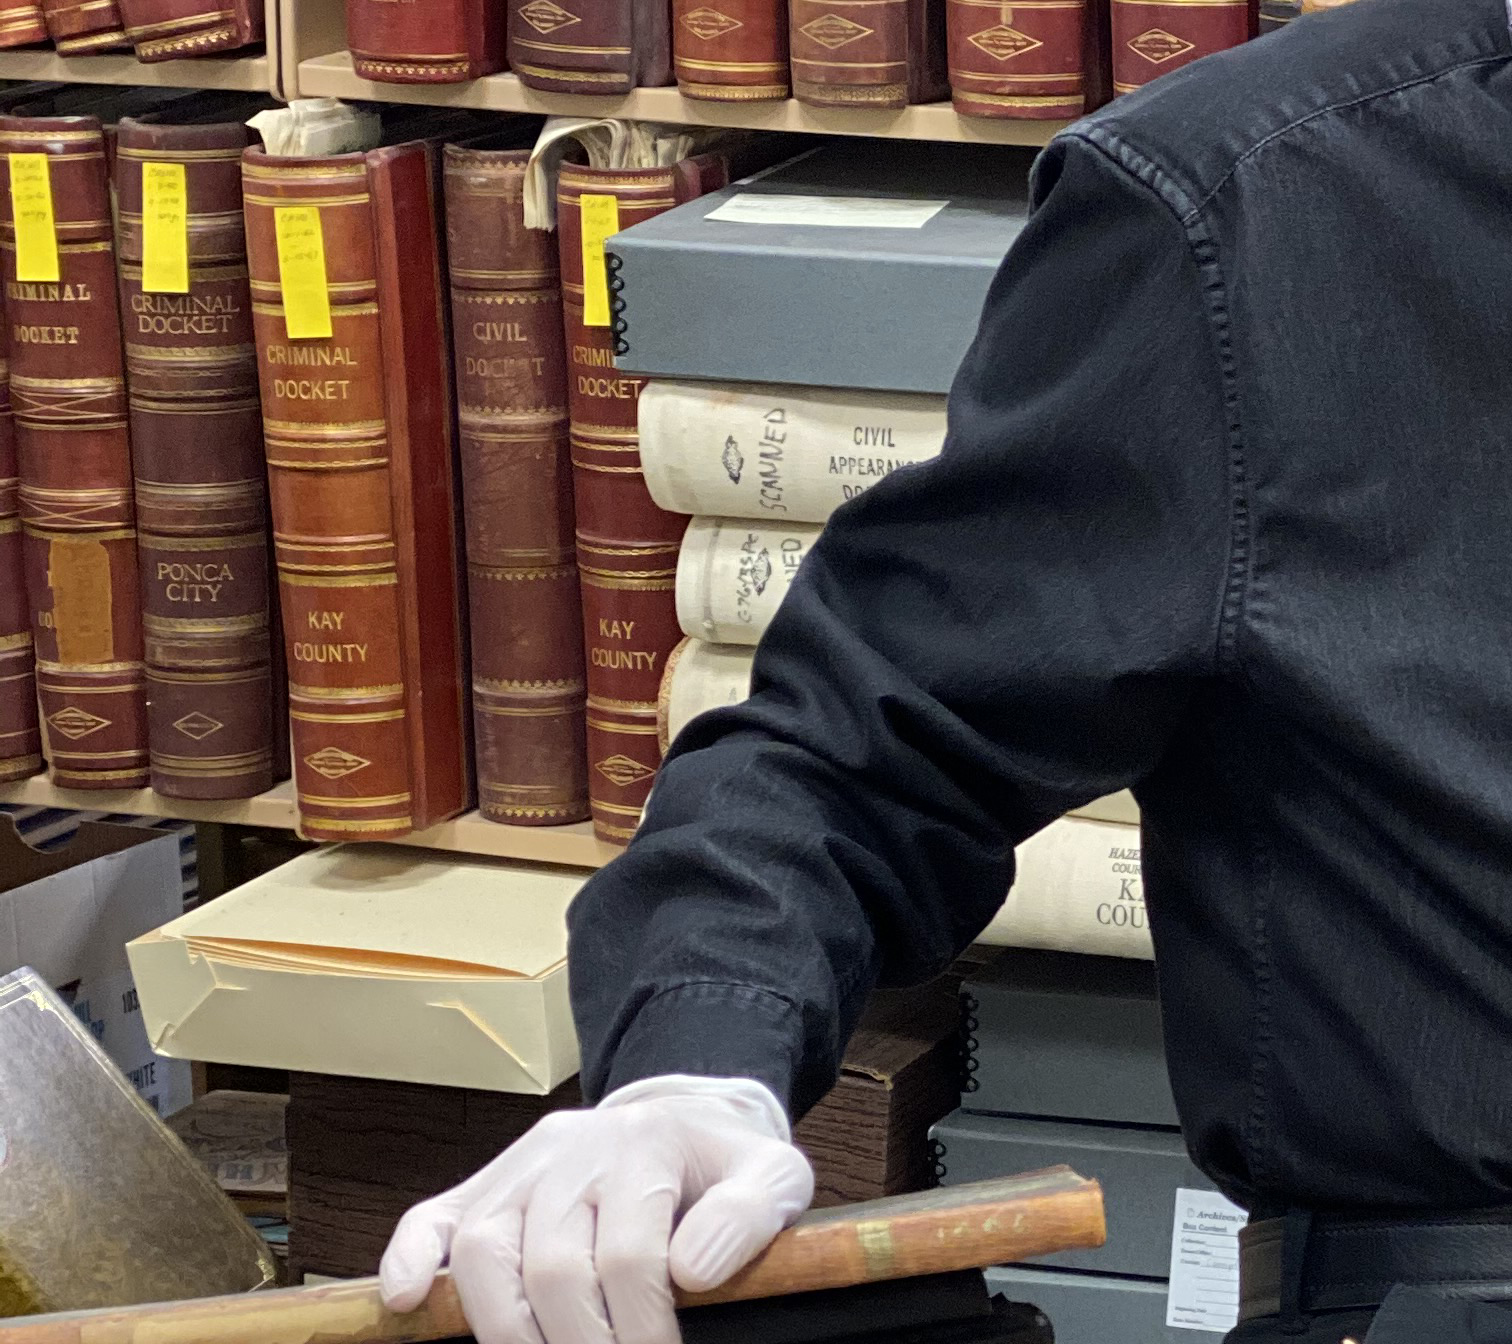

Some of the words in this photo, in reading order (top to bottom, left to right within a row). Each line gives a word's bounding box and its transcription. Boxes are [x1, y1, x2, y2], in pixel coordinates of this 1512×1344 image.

[131, 295, 240, 314] CRIMINAL
[138, 315, 233, 334] DOCKET
[473, 322, 528, 342] CIVIL
[266, 346, 357, 366] CRIMINAL
[274, 380, 350, 400] DOCKET
[577, 377, 642, 399] DOCKET
[853, 426, 896, 448] CIVIL
[759, 407, 788, 512] SCANNED
[157, 563, 234, 582] PONCA
[165, 583, 223, 603] CITY
[308, 611, 344, 630] KAY
[600, 617, 636, 641] KAY
[294, 643, 368, 664] COUNTY
[591, 647, 658, 672] COUNTY
